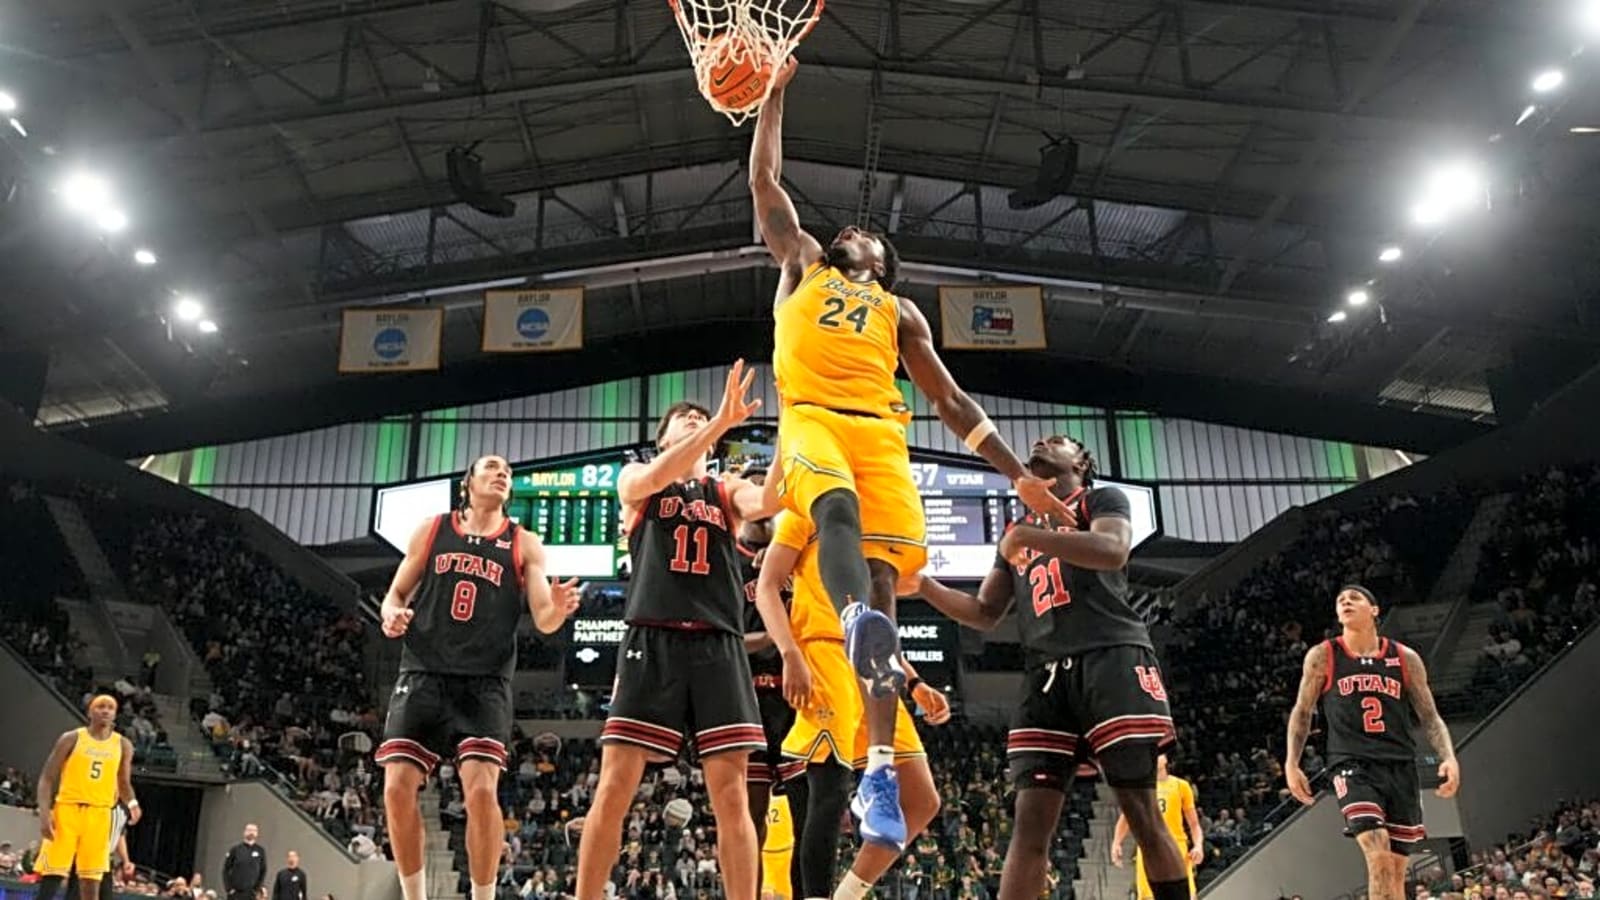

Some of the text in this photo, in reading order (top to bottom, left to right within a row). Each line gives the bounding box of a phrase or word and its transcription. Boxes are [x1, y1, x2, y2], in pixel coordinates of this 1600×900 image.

[819, 297, 869, 334] 24
[532, 464, 614, 488] BAYLOR 82
[946, 473, 984, 486] UTAH
[659, 496, 727, 531] UTAH
[669, 525, 710, 575] 11
[435, 552, 504, 587] UTAH
[451, 580, 477, 622] 8
[1029, 557, 1071, 618] 21
[574, 619, 629, 631] CHAMPIO
[898, 625, 938, 639] ANCE
[1337, 674, 1401, 700] UTAH
[1361, 696, 1385, 733] 2
[90, 760, 103, 780] 5
